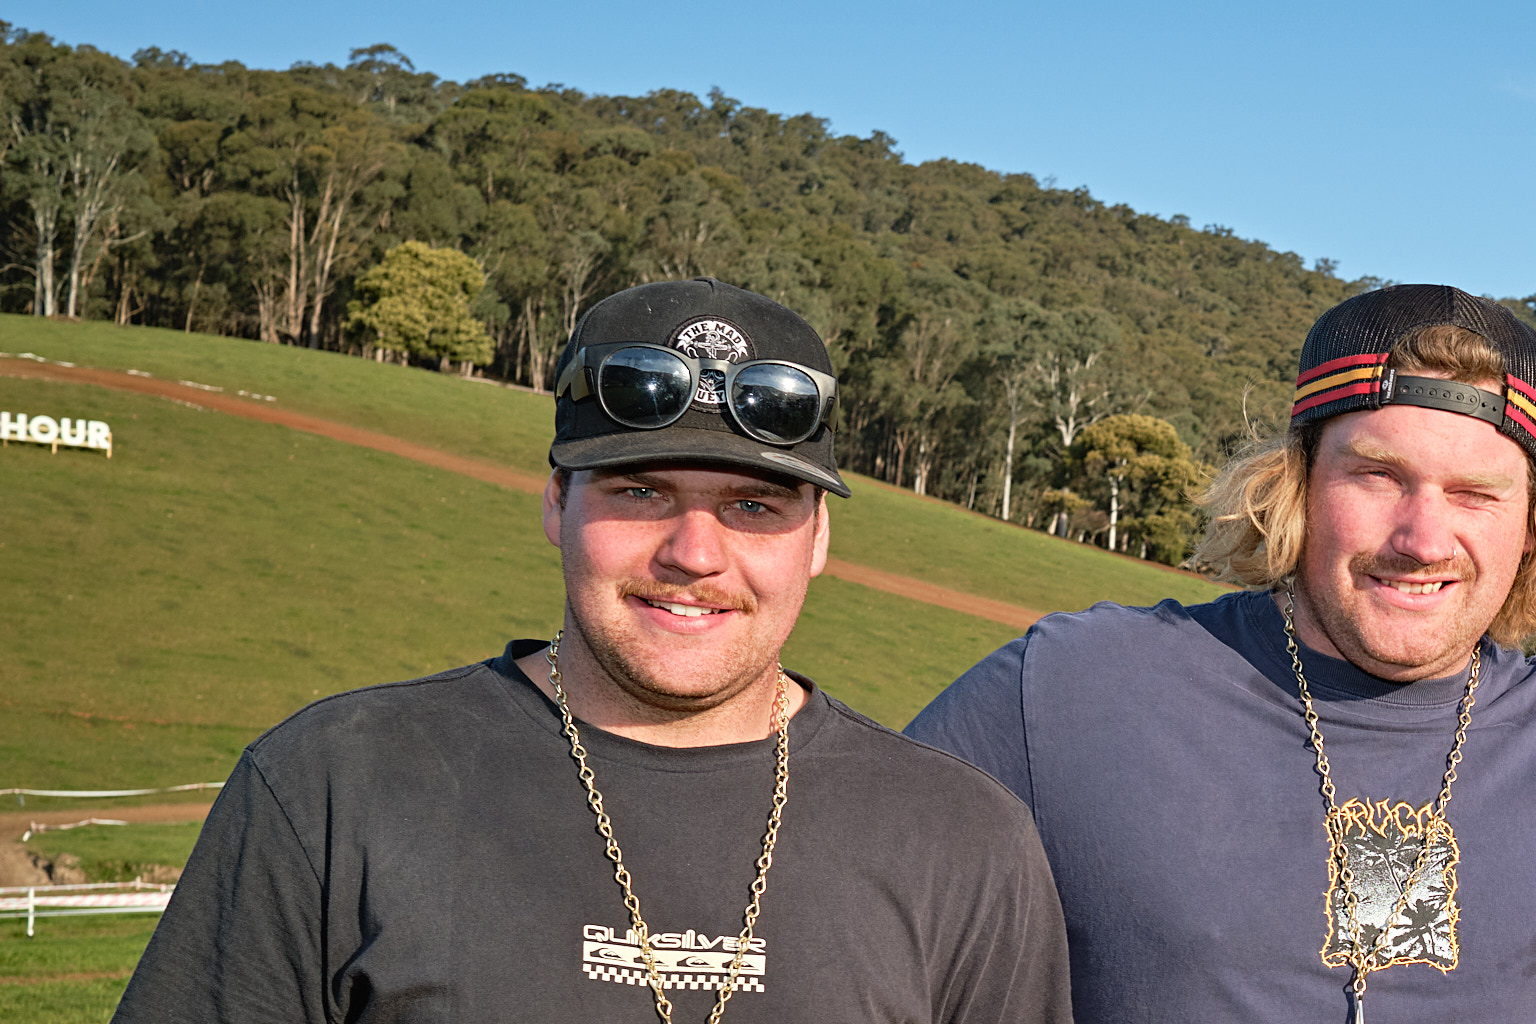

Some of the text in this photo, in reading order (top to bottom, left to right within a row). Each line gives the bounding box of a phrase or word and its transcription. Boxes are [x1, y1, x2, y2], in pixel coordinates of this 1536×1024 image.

[683, 322, 742, 344] THE MAD
[696, 391, 725, 402] UEY
[0, 411, 111, 449] HOUR
